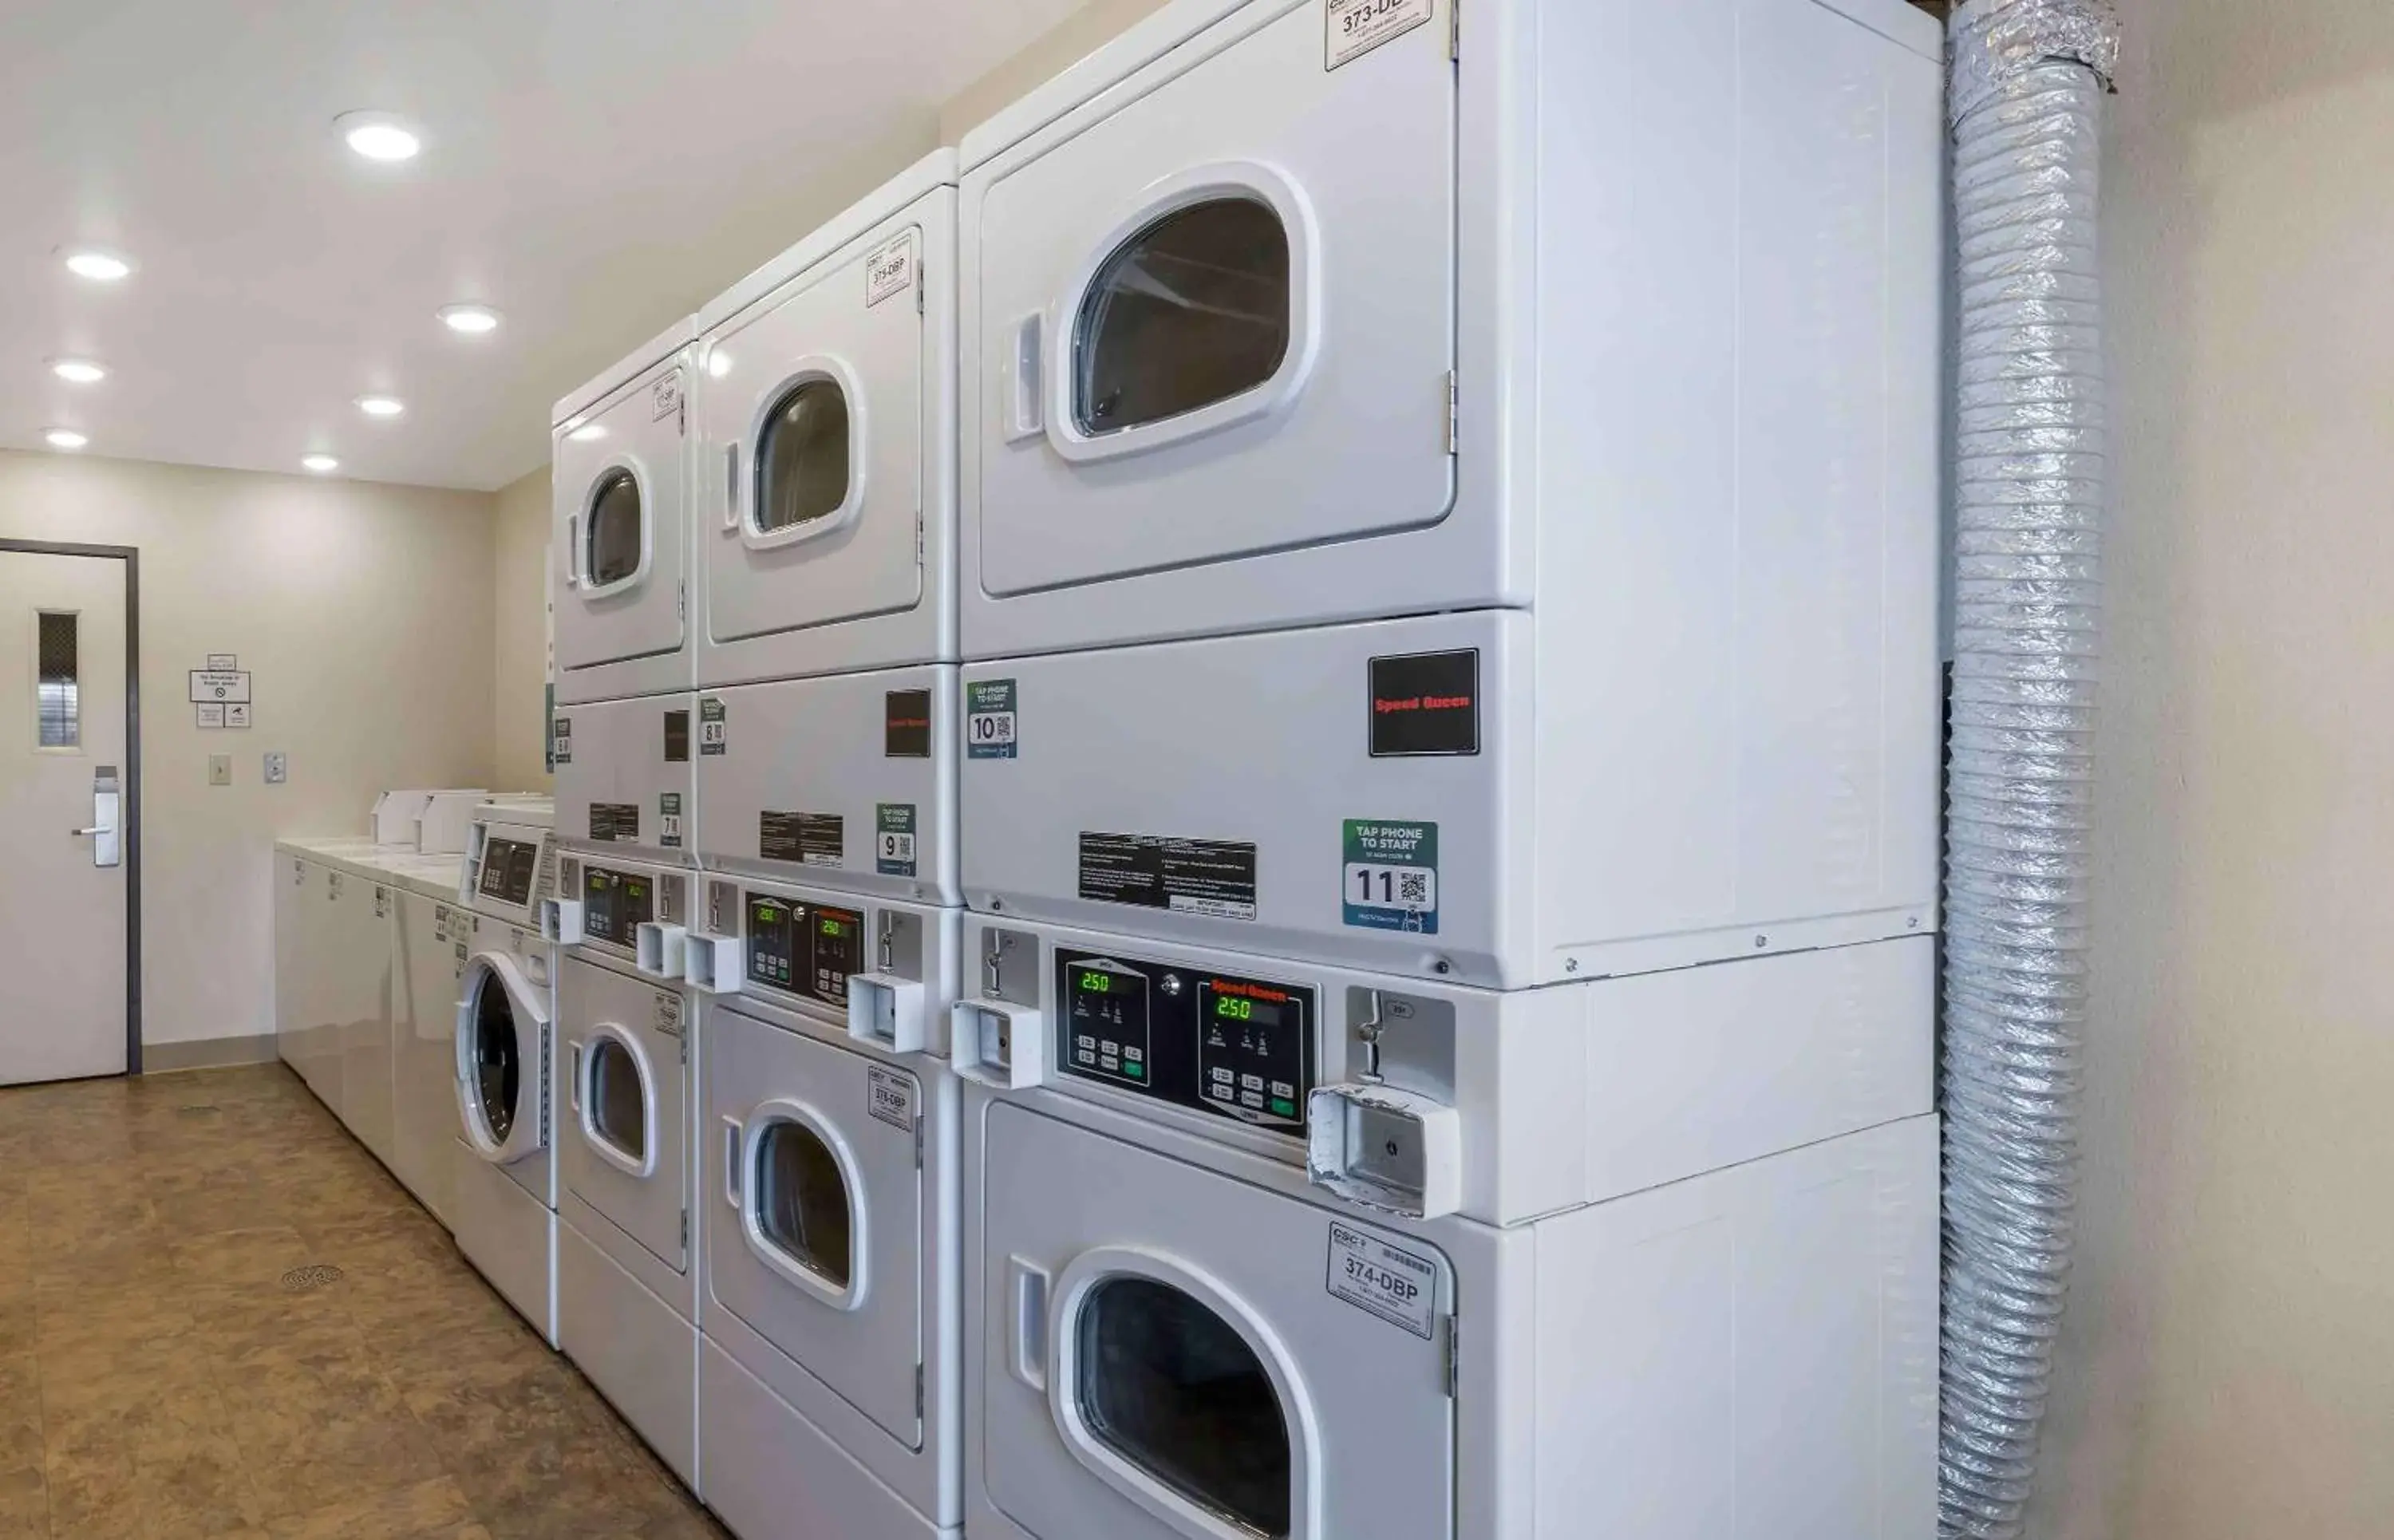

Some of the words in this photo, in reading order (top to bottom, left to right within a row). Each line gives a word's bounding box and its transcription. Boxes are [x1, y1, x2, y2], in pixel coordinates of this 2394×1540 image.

[1375, 697, 1419, 715] Speed
[1423, 696, 1470, 709] Queen
[974, 717, 995, 740] 10
[1356, 825, 1378, 837] TAP
[1381, 827, 1423, 839] PHONE
[886, 835, 895, 856] 9
[1361, 837, 1377, 848] TO
[1380, 839, 1417, 850] START
[1357, 869, 1393, 902] 11
[1345, 1257, 1419, 1301] 374-DBP
